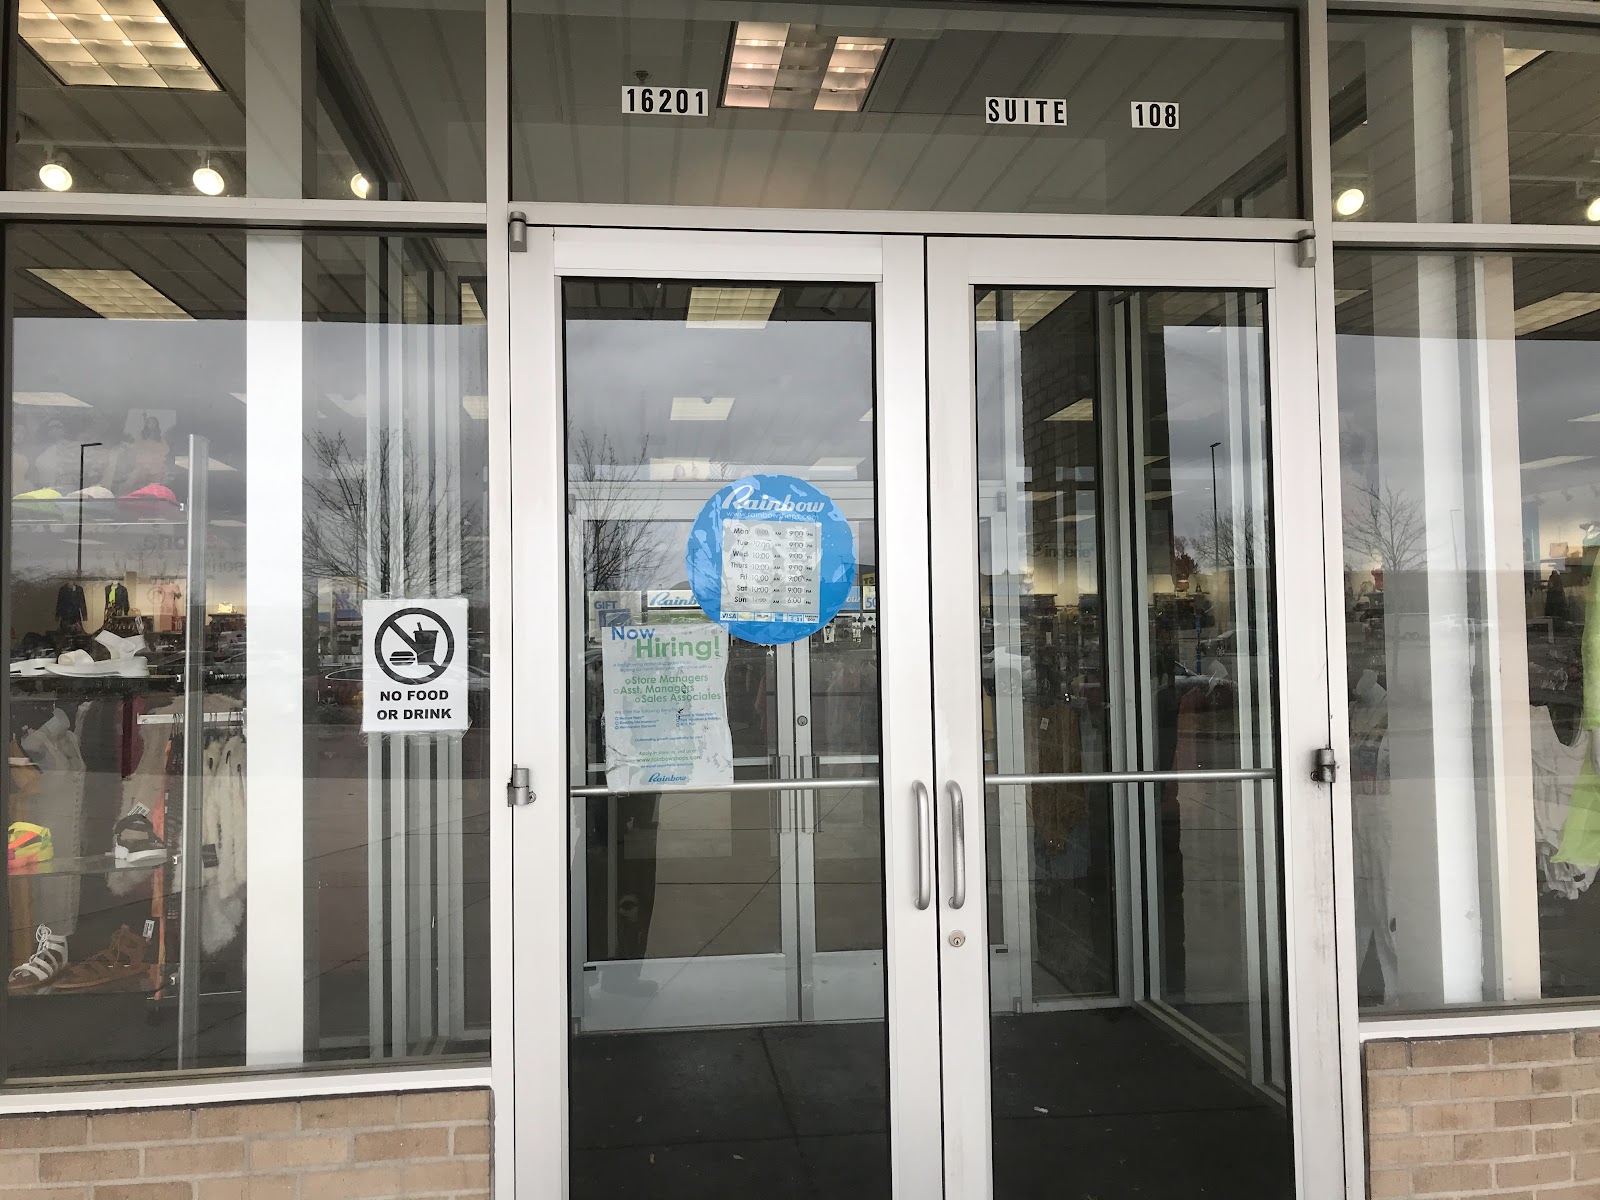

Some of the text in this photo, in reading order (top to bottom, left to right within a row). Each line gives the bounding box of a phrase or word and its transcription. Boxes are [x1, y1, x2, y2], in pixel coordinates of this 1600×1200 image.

[627, 88, 703, 114] 16201
[988, 98, 1176, 128] SUITE 108
[722, 485, 825, 513] Rainbow
[752, 563, 769, 571] 10:00
[649, 591, 698, 606] Rainb
[594, 600, 618, 610] GIFT
[611, 626, 655, 640] Now
[636, 636, 720, 661] Hiring!
[631, 673, 709, 685] Store Managers
[620, 683, 695, 695] Asst. Managers
[380, 690, 449, 702] NO FOOD
[641, 691, 722, 703] Sales Associates
[377, 708, 452, 720] OR DRINK
[648, 772, 687, 782] Rainbow
